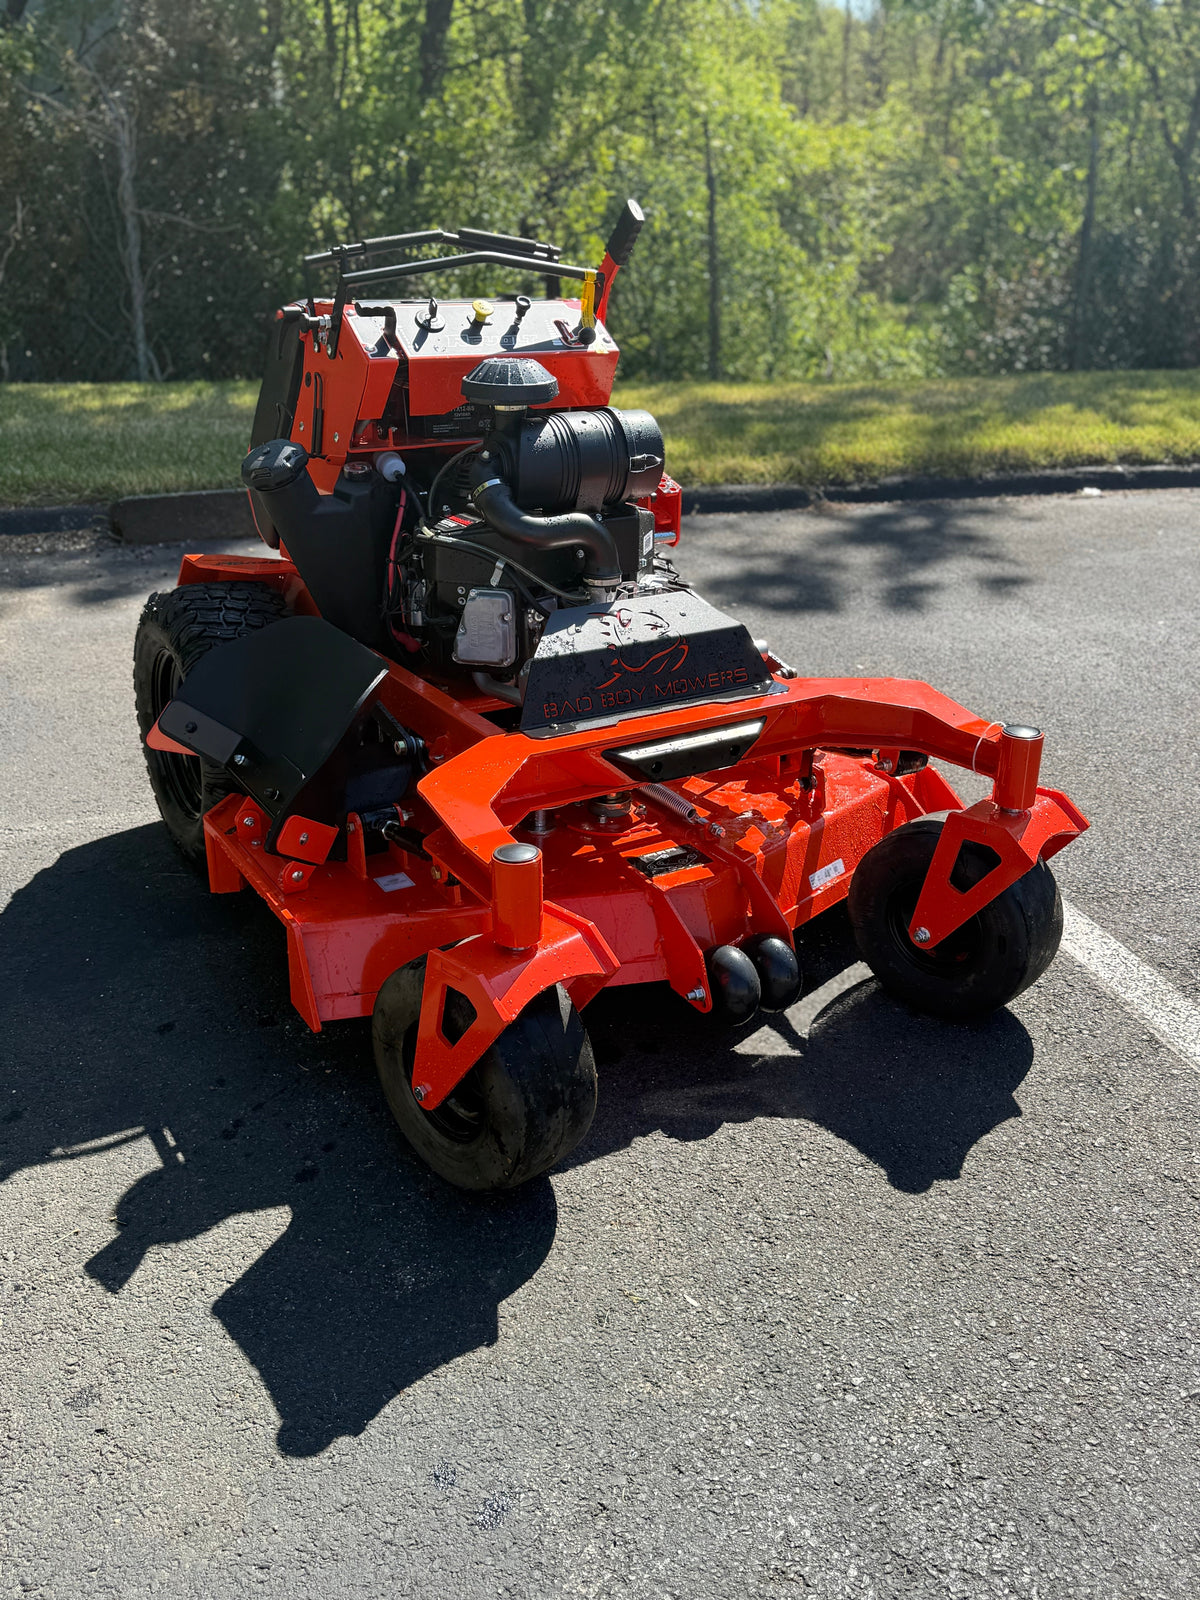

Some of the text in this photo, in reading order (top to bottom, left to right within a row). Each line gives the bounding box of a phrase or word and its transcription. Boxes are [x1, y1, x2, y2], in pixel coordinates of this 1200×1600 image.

[543, 668, 748, 718] BAD BOY MOWERS
